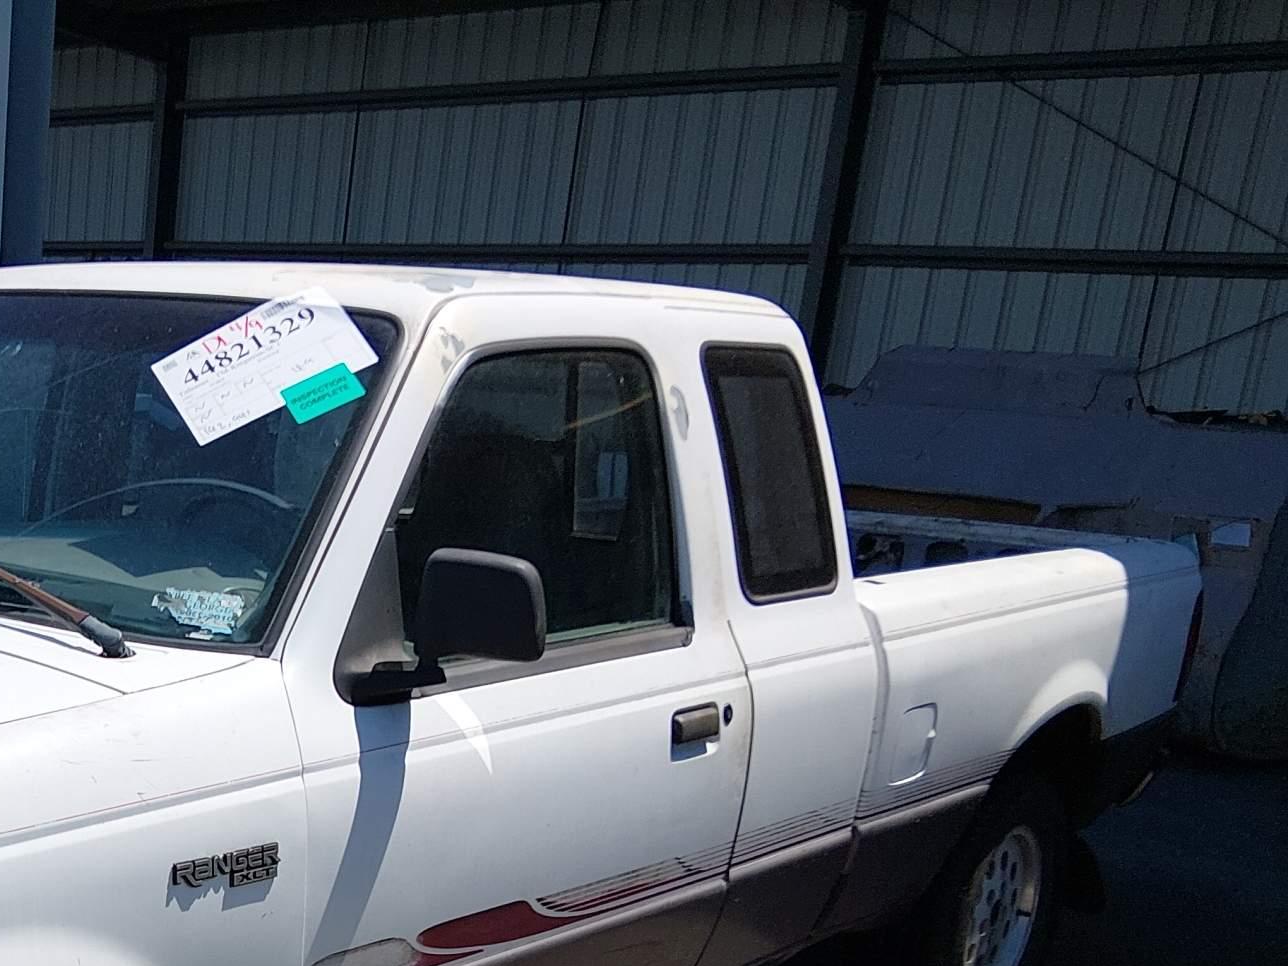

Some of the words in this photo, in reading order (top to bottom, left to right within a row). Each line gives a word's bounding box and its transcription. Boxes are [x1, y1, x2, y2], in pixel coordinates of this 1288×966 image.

[183, 307, 315, 385] 44821329
[291, 376, 347, 404] INSPECTION
[299, 384, 349, 410] COMPLETE
[172, 842, 281, 887] RANGER
[236, 867, 276, 884] XLT
